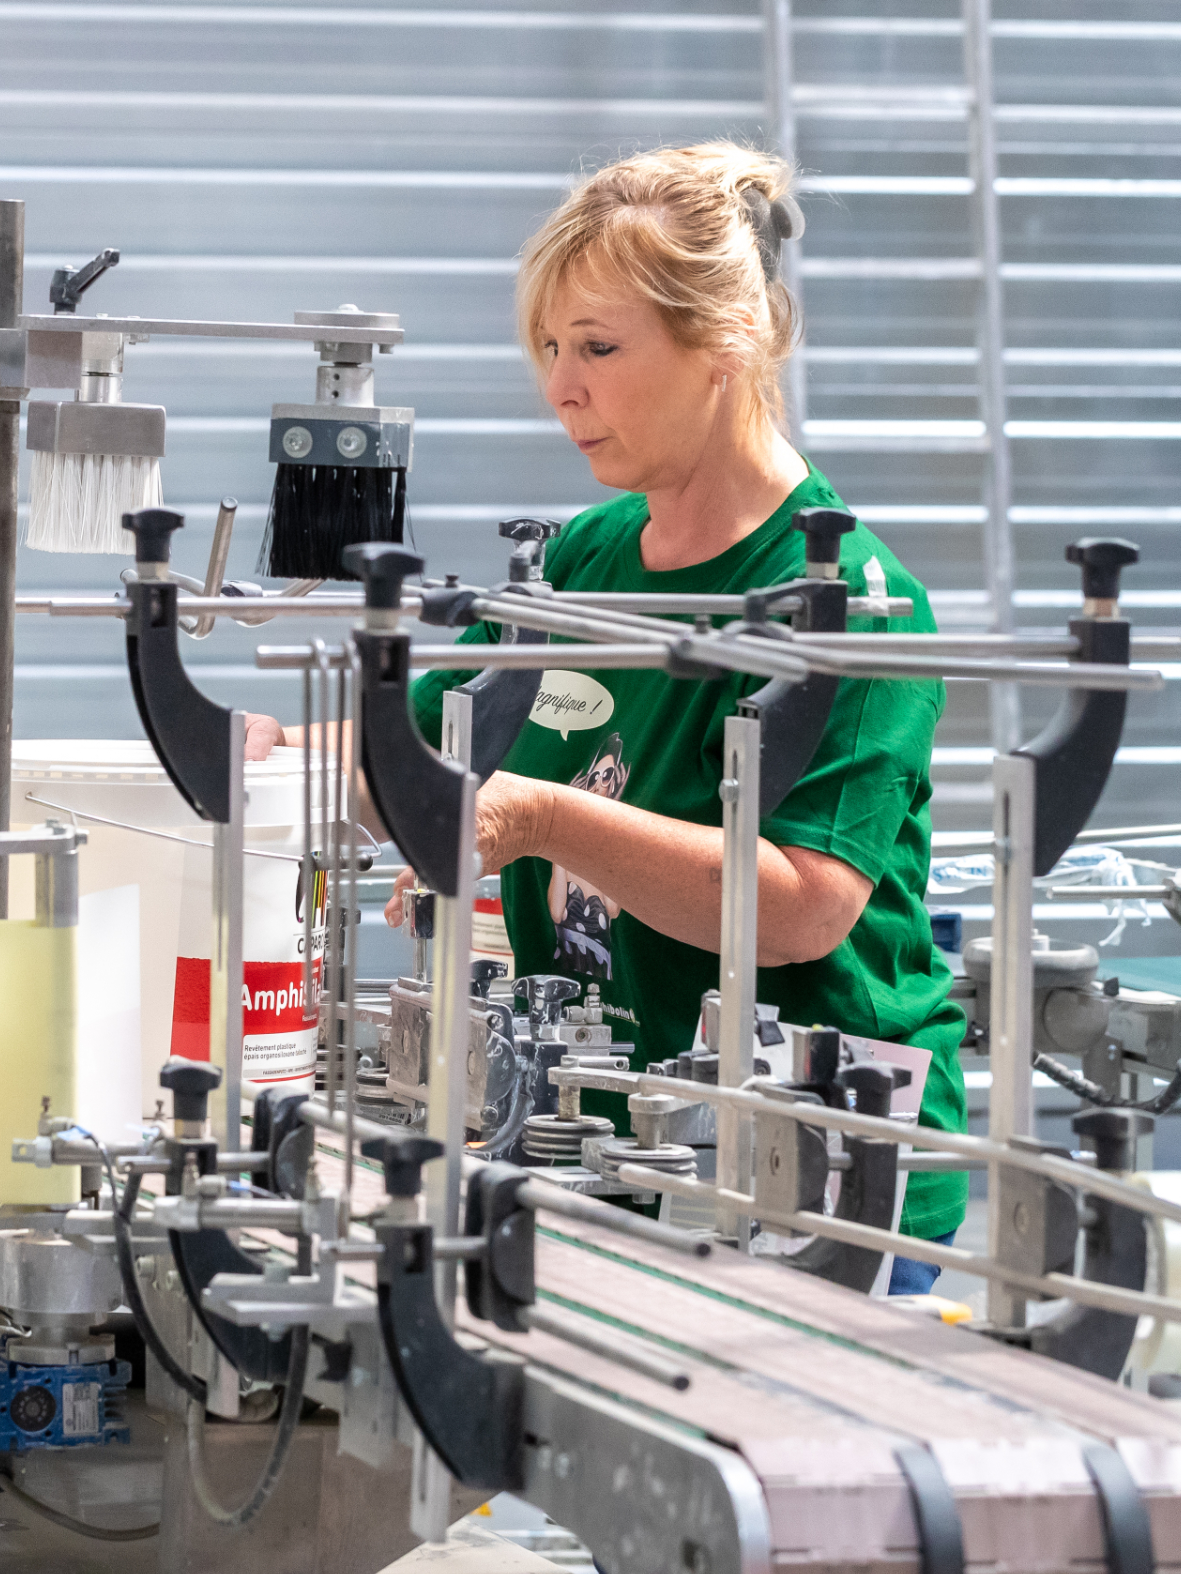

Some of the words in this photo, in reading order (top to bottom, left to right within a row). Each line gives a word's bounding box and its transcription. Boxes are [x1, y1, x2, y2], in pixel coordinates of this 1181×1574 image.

[535, 689, 587, 715] agnifique
[589, 699, 603, 715] !
[600, 1001, 630, 1020] hibolin
